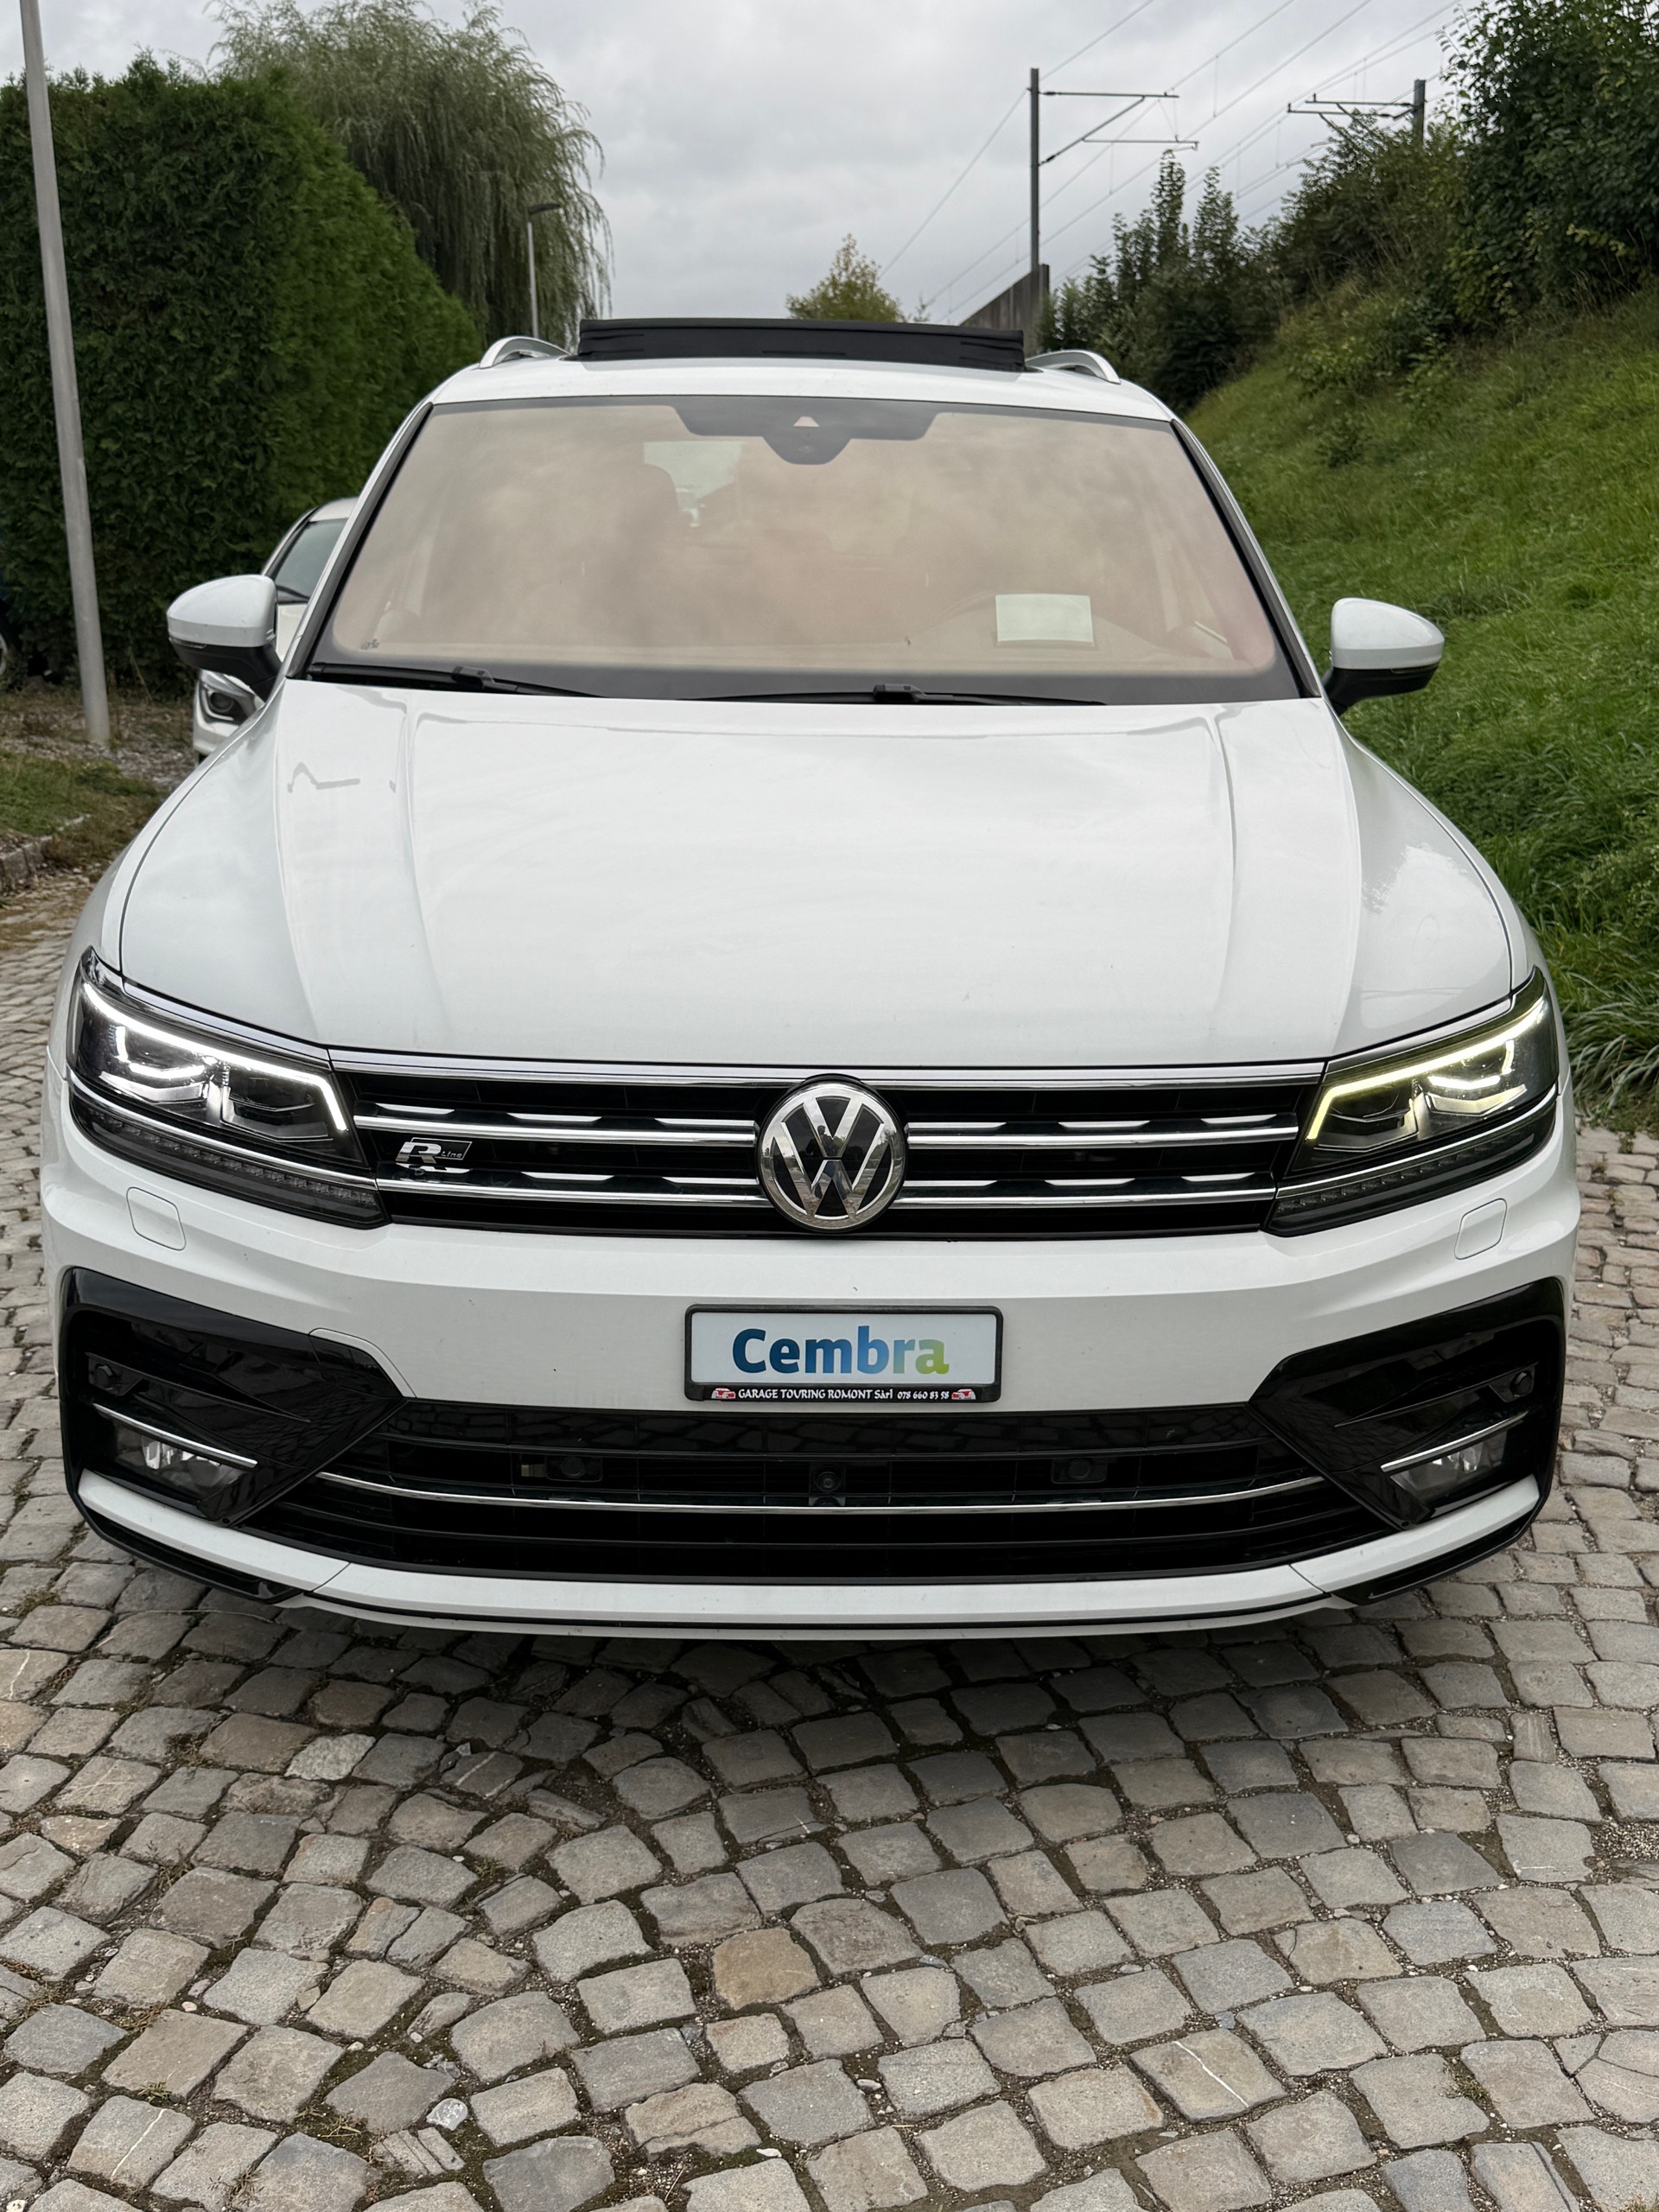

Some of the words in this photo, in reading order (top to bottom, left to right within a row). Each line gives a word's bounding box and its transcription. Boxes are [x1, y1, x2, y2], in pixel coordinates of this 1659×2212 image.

[395, 1141, 442, 1164] R
[763, 1084, 901, 1227] VW
[732, 1325, 950, 1375] Cembra
[738, 1389, 779, 1399] GARAGE
[779, 1389, 826, 1399] TOURING
[827, 1389, 874, 1399] ROMONT
[897, 1390, 912, 1400] 078
[912, 1390, 928, 1400] 660
[929, 1390, 939, 1400] 83
[940, 1390, 950, 1400] 58
